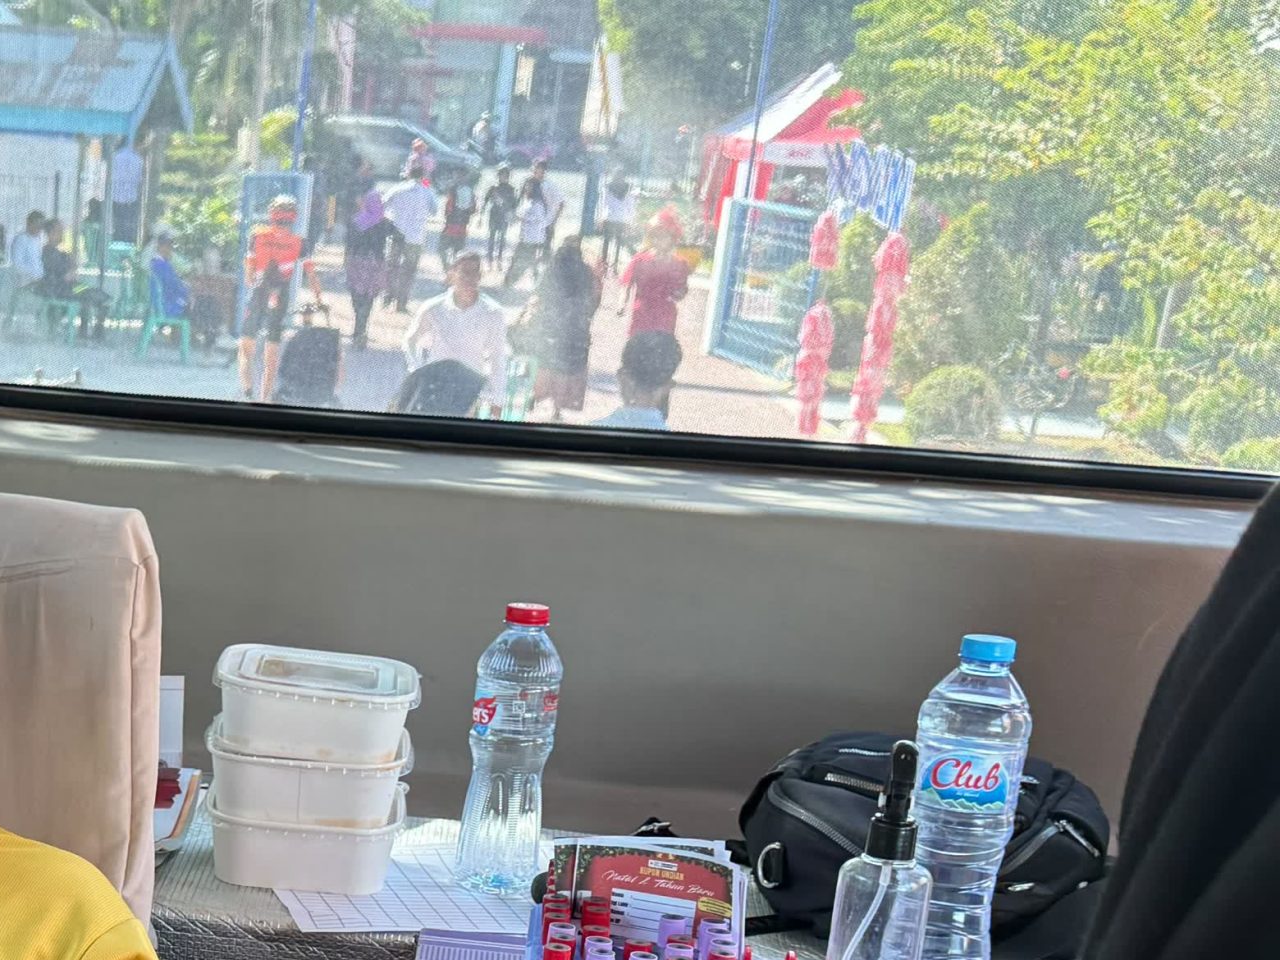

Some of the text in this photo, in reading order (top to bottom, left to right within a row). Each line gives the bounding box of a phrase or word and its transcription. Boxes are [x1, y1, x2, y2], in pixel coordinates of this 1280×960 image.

[929, 757, 1001, 791] Club
[602, 870, 637, 884] Natal
[654, 879, 685, 891] Tahun
[687, 884, 715, 896] Baru
